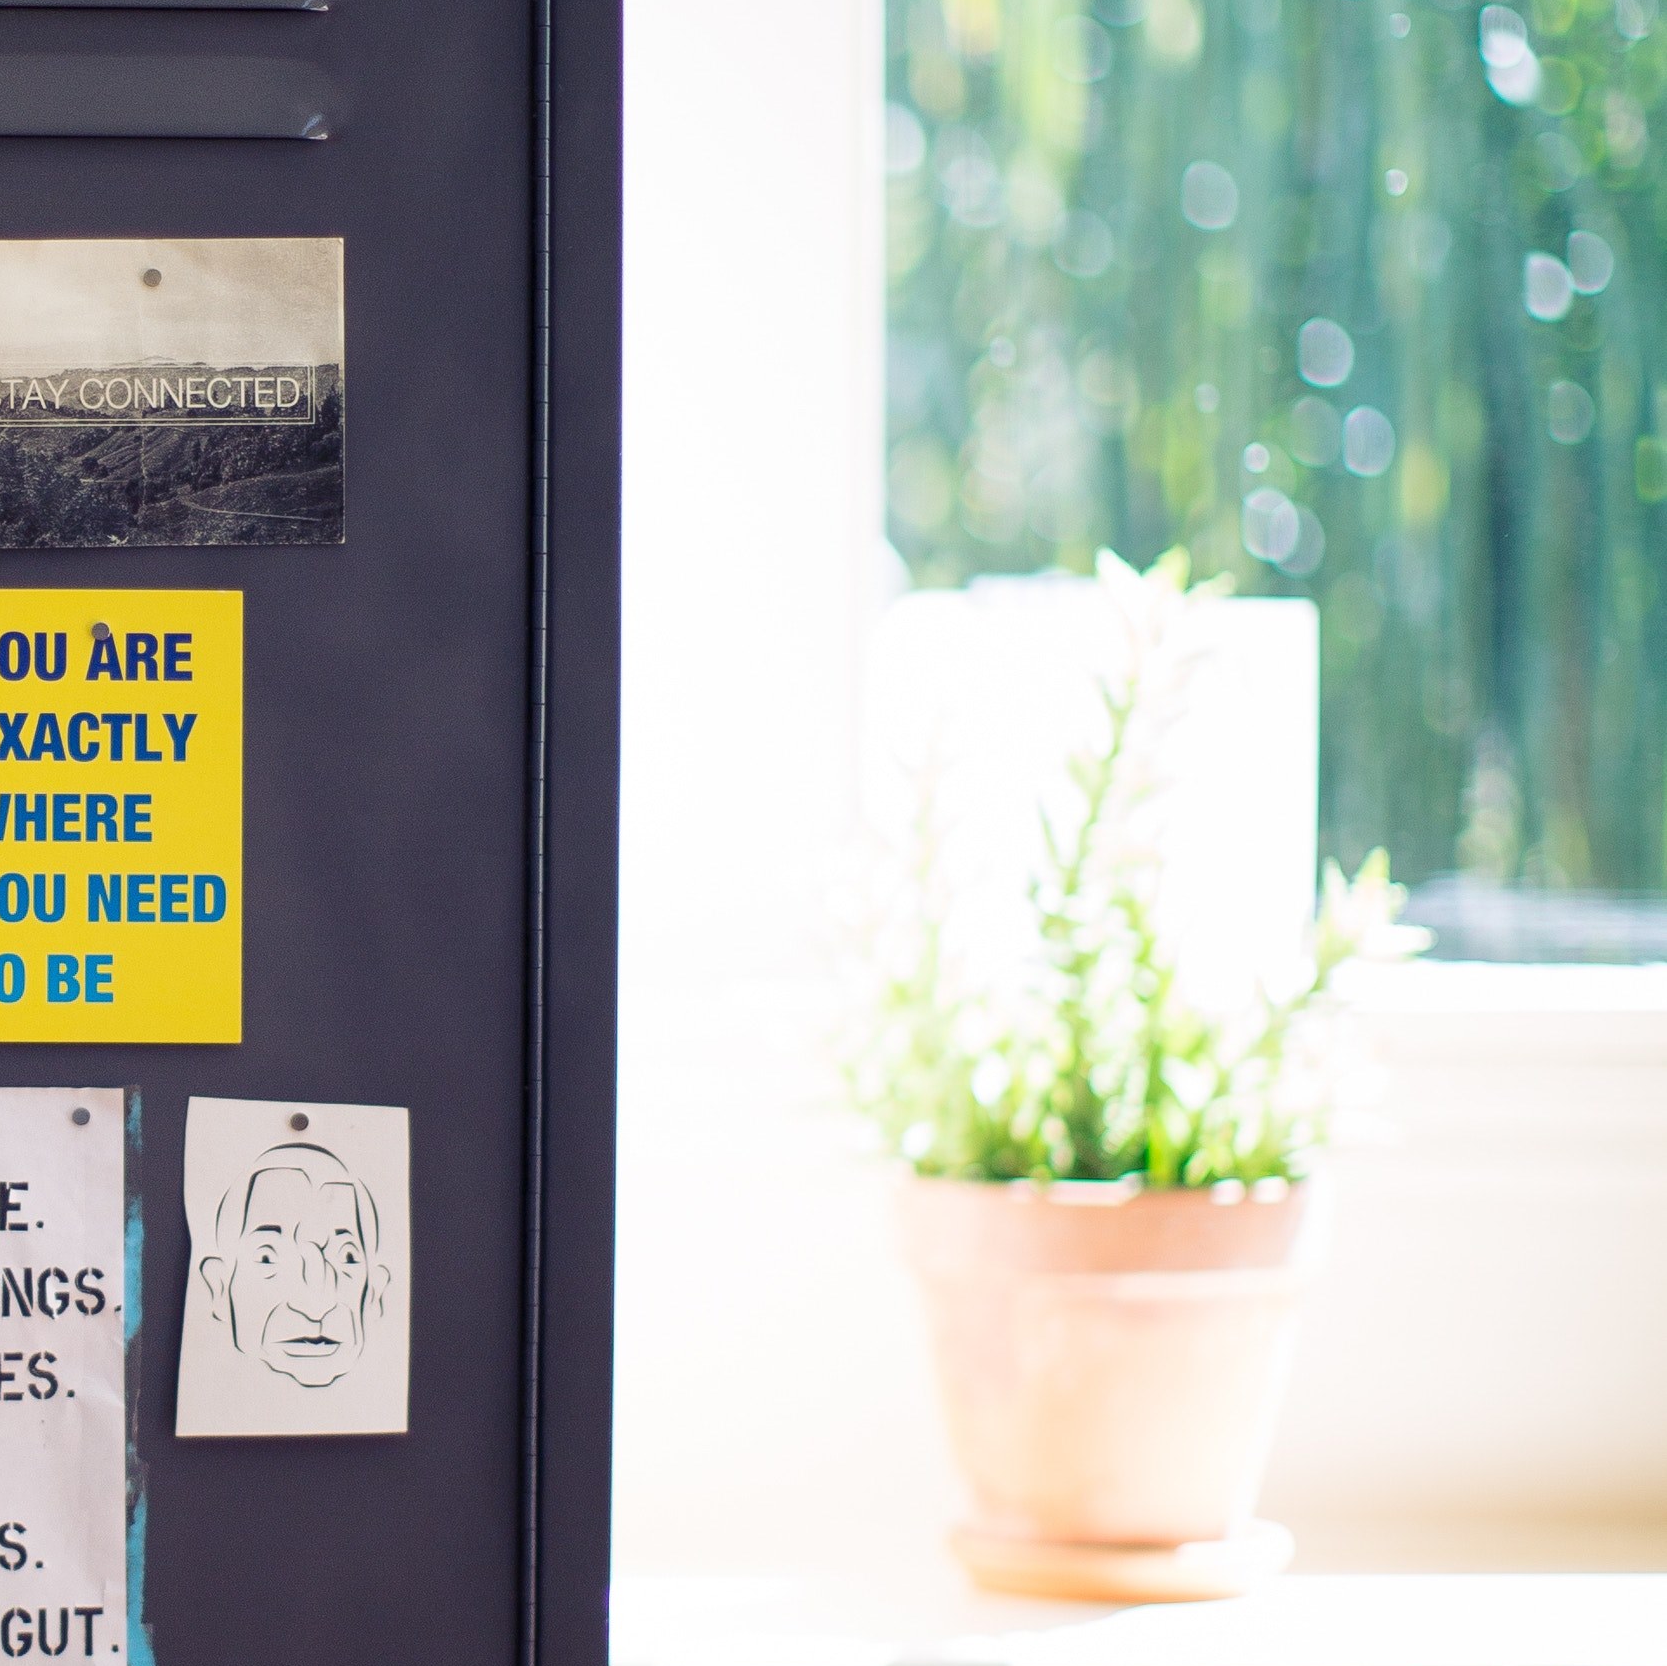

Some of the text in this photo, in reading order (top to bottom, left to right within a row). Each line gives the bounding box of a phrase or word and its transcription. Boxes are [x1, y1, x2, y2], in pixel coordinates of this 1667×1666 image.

[79, 376, 300, 410] CONNECTED
[86, 632, 193, 681] ARE
[88, 874, 227, 923] NEED
[47, 954, 114, 1003] BE
[0, 1606, 120, 1657] GUT.
